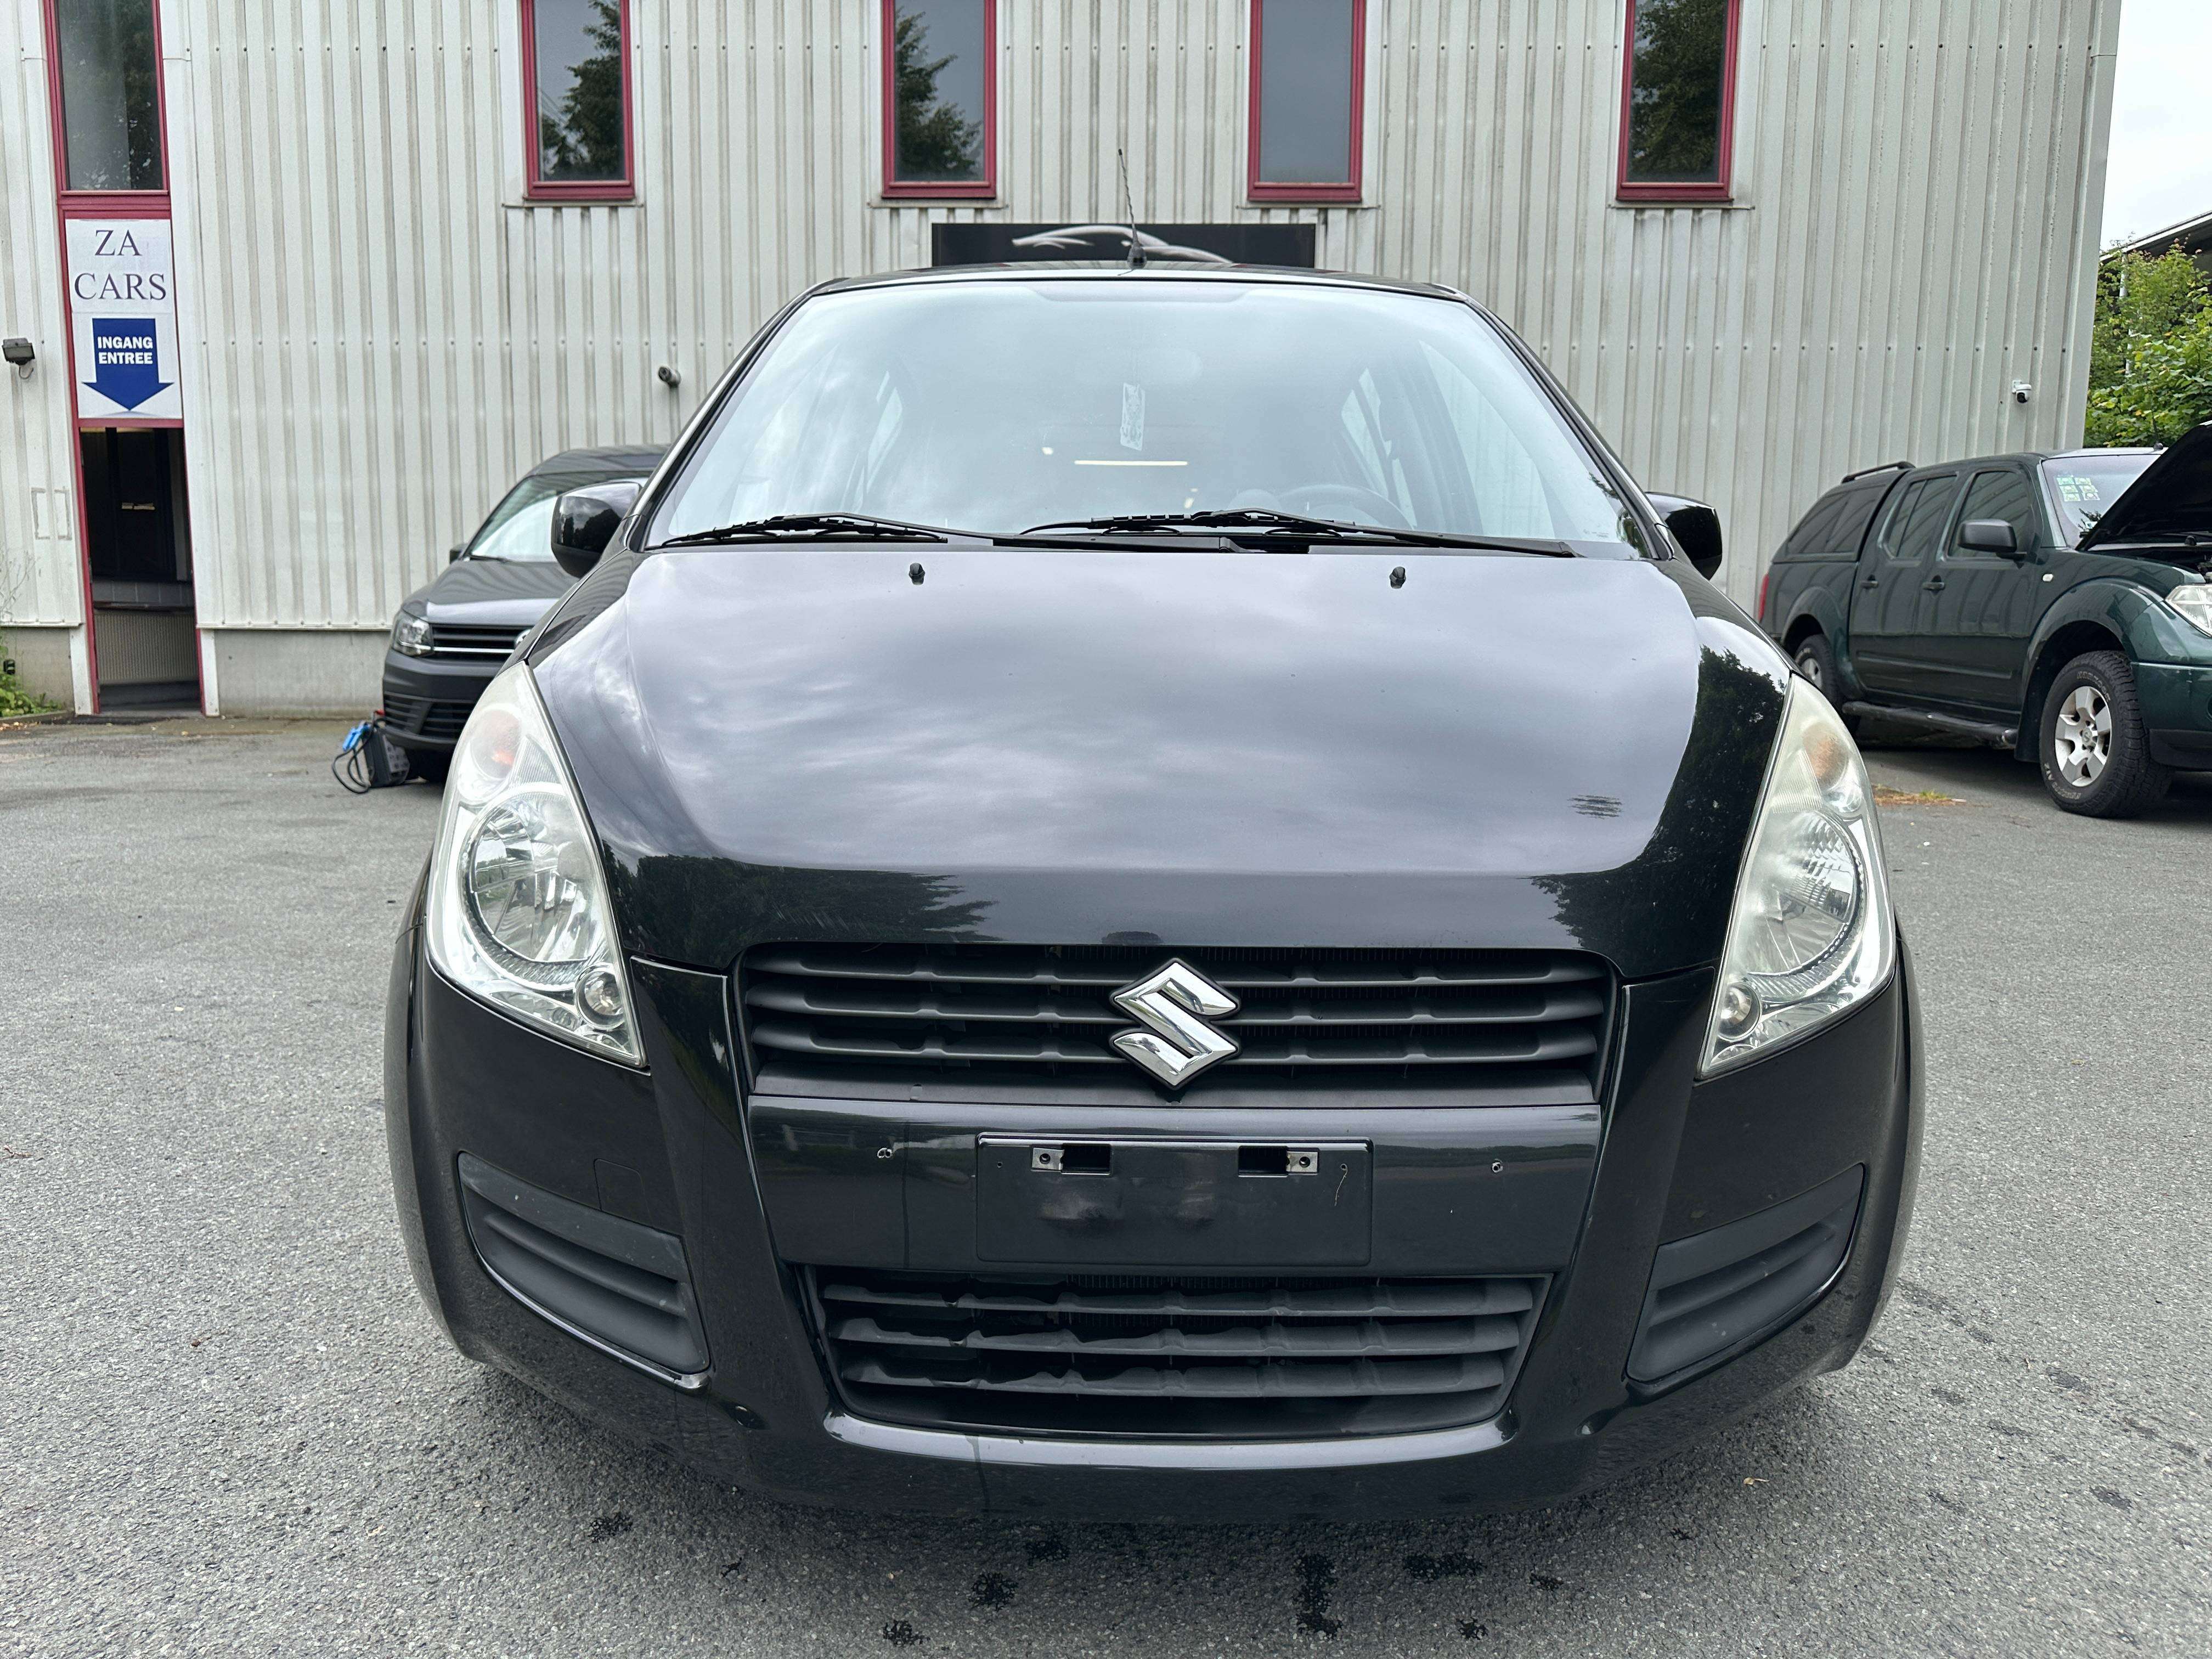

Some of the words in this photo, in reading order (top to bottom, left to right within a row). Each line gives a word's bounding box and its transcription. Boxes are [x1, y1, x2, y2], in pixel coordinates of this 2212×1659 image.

[95, 229, 142, 256] ZA
[75, 273, 166, 300] CARS
[97, 336, 153, 349] INGANG
[98, 352, 153, 364] ENTREE
